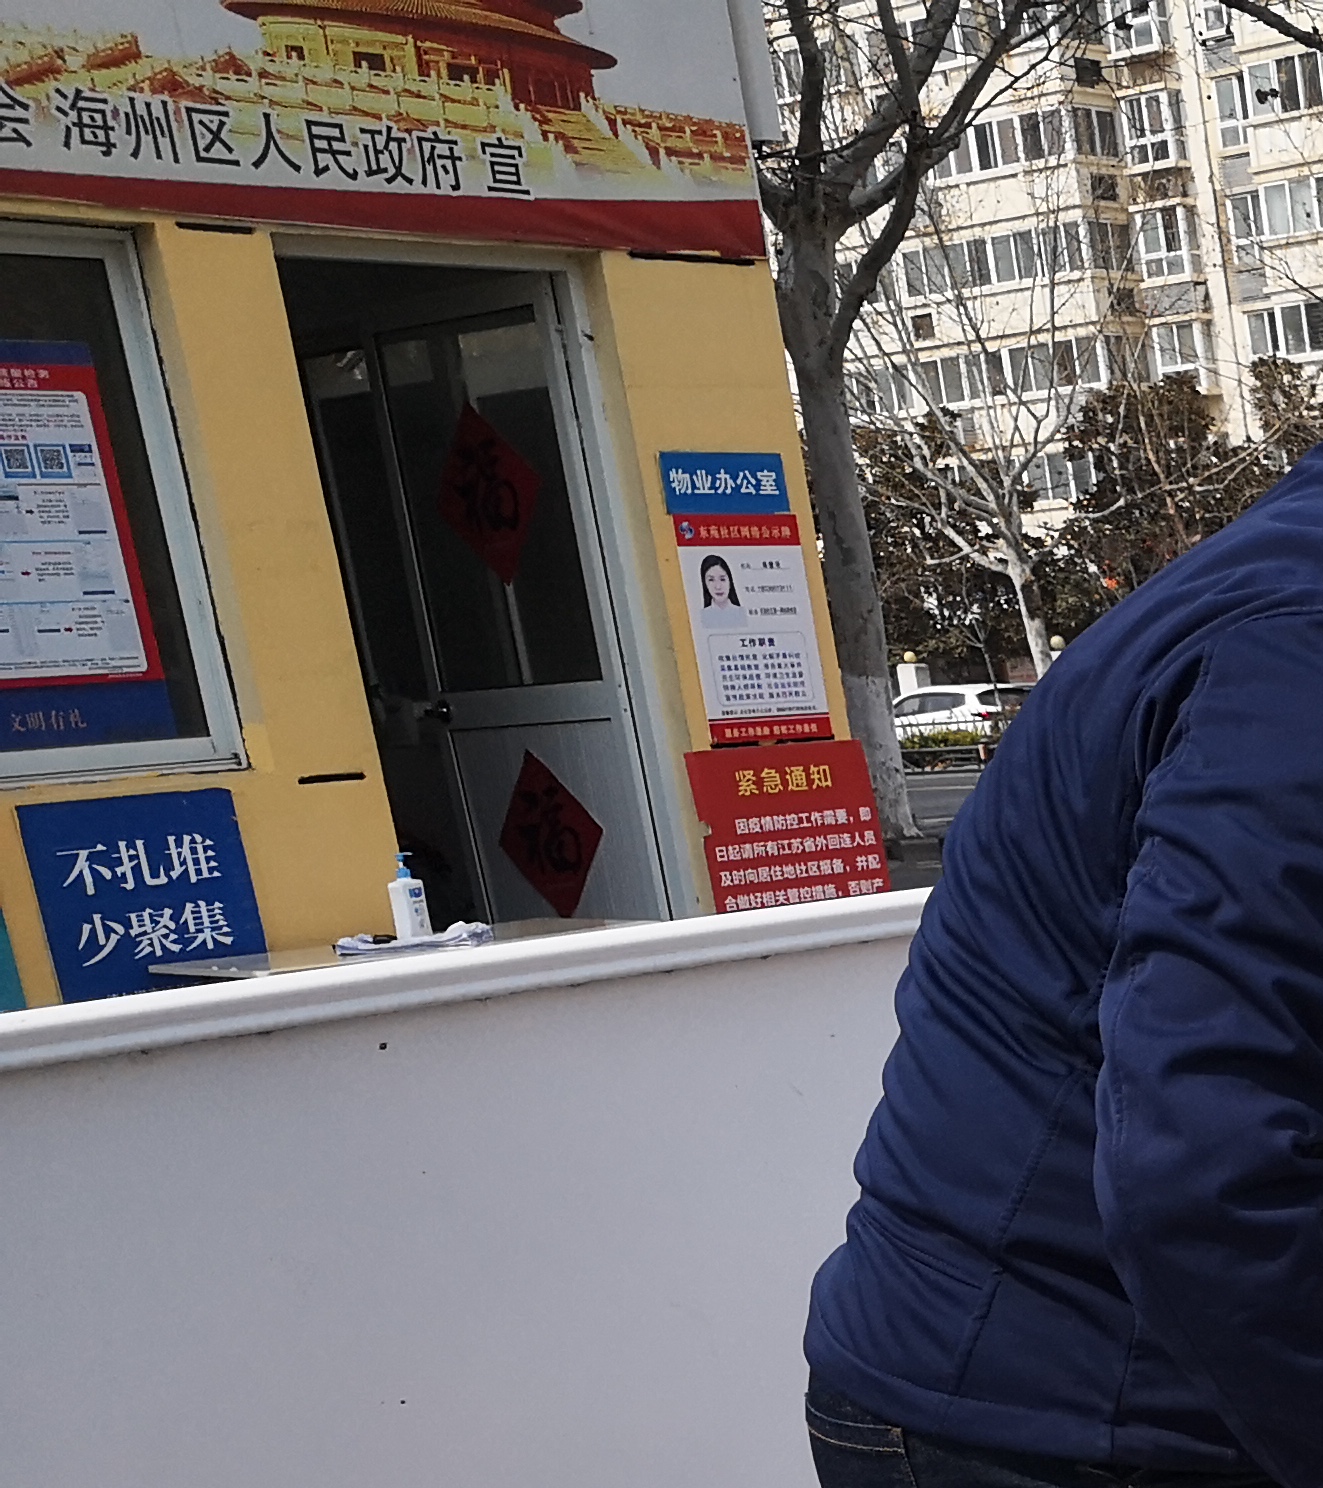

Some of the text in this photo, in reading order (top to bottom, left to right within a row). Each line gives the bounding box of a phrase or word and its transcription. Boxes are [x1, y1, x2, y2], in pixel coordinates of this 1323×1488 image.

[53, 86, 465, 192] 海州区人民政府
[479, 136, 532, 197] 宣
[668, 467, 780, 495] 物业办公室
[735, 764, 833, 797] 紧急通知
[56, 833, 222, 896] 不扎堆
[719, 854, 882, 887] 及时向居住地社区报备，并配
[78, 900, 235, 967] 少聚集
